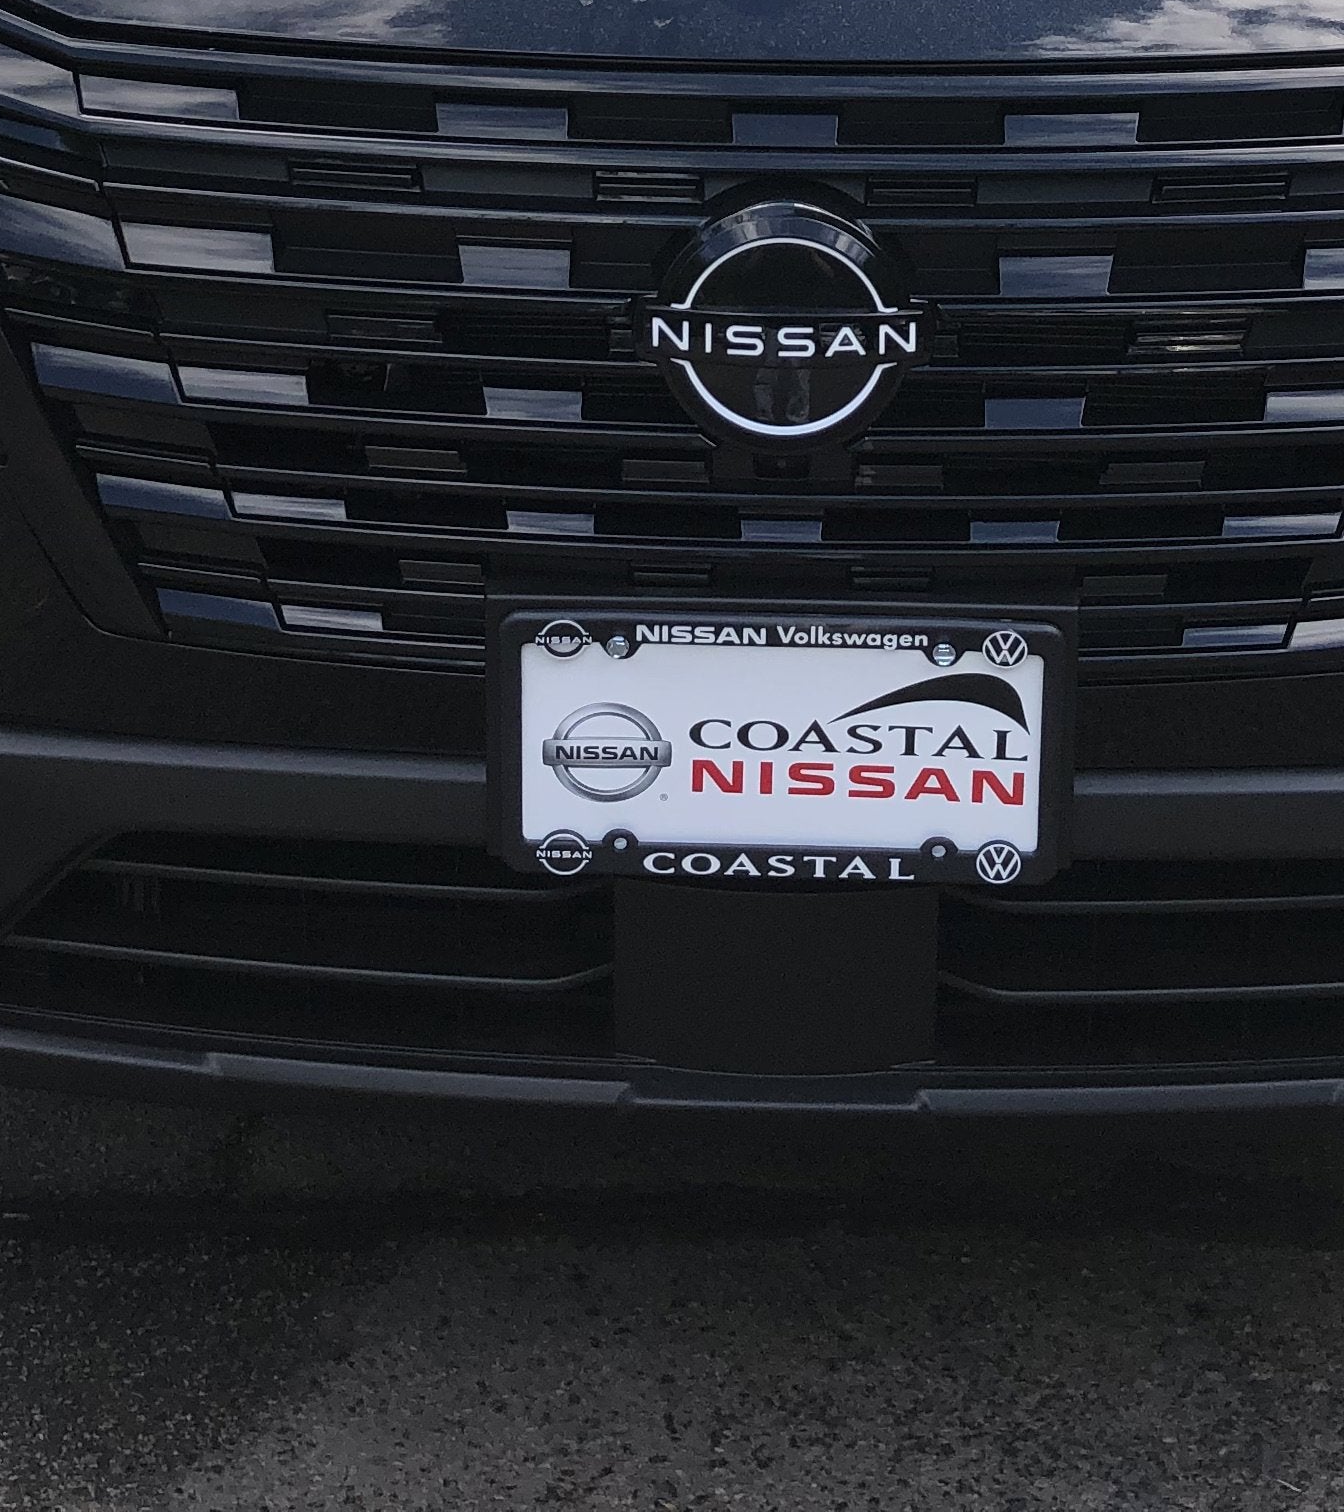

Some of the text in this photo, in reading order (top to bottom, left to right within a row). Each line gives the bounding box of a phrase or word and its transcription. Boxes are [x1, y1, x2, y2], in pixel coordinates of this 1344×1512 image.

[651, 317, 917, 358] NISSAN
[535, 635, 593, 645] NISSAN
[635, 624, 928, 650] NISSAN Volkswagen
[555, 745, 659, 761] NISSAN
[688, 718, 1029, 762] COASTAL
[691, 760, 1025, 806] NISSAN
[535, 849, 593, 859] NISSAN
[642, 852, 915, 881] COASTAL
